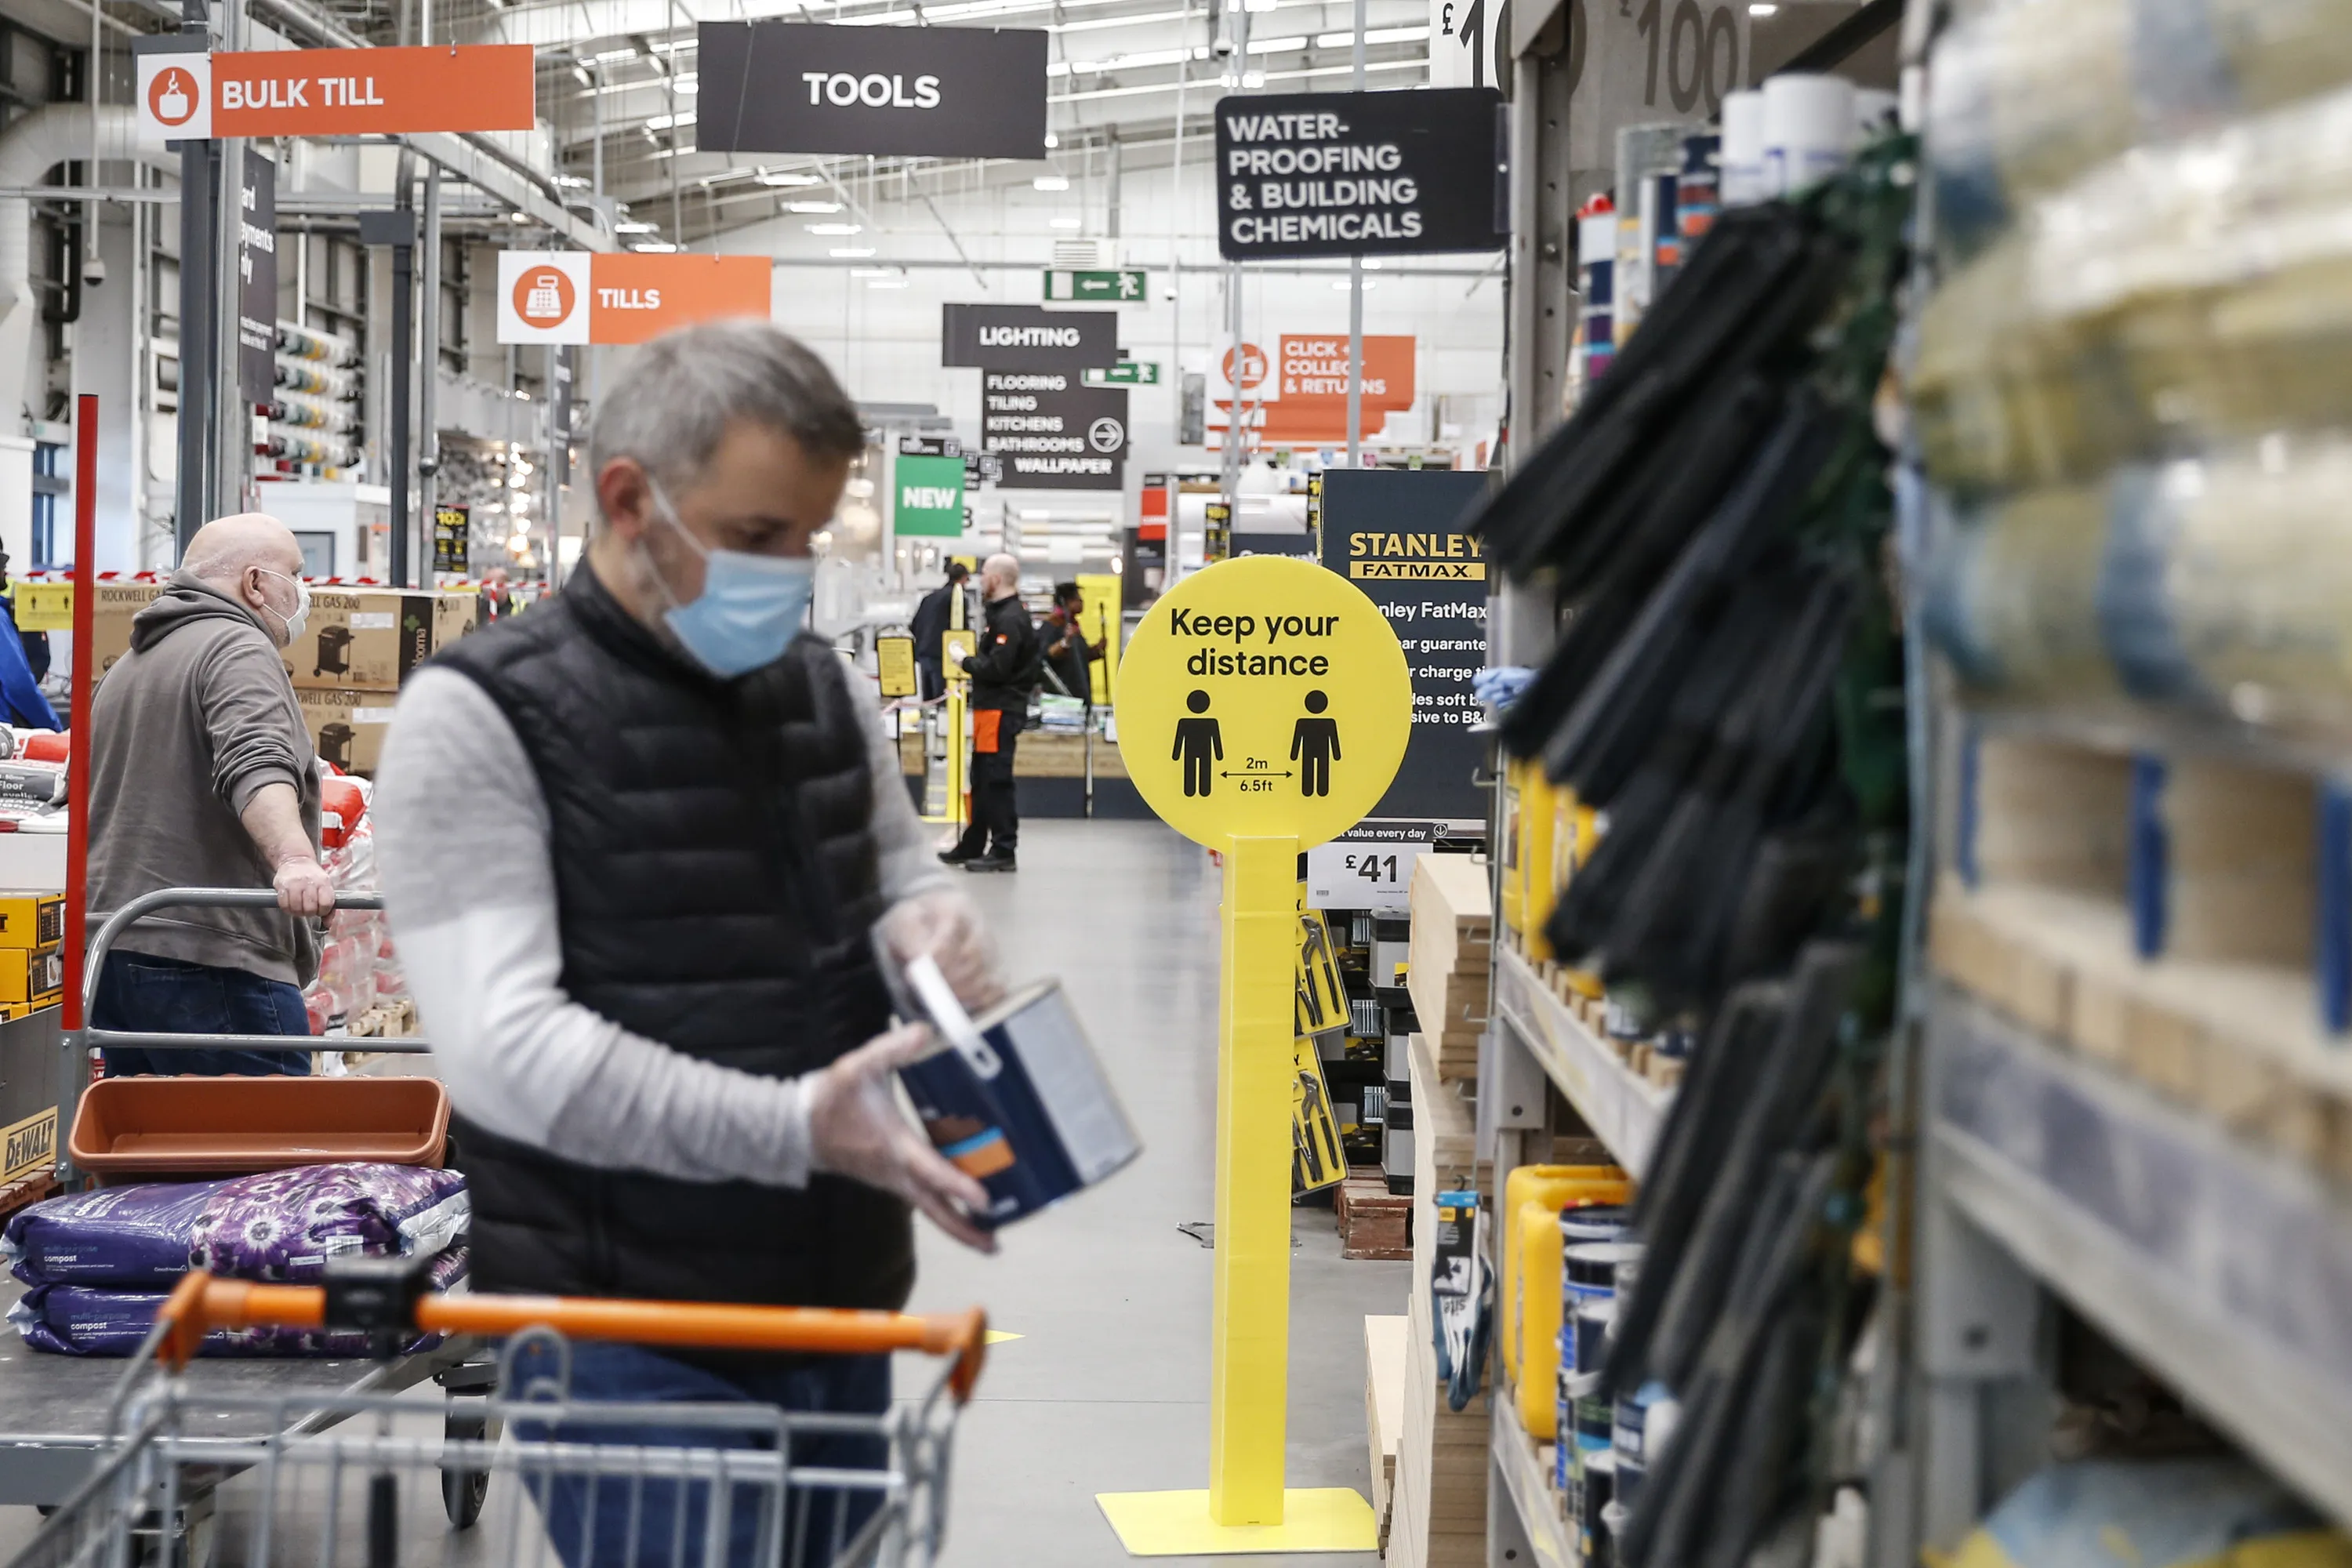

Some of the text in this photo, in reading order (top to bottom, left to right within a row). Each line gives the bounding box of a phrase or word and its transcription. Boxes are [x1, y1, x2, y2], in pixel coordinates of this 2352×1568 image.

[222, 77, 384, 109] BULK TILL
[802, 72, 942, 109] TOOLS
[1227, 114, 1350, 142] WATER-
[1229, 145, 1402, 176] PROOFING
[241, 185, 256, 212] ard
[1229, 178, 1418, 210] & BUILDING
[1231, 212, 1423, 244] CHEMICALS
[241, 220, 274, 254] ayments
[241, 250, 254, 285] nly
[597, 288, 662, 310] TILLS
[980, 326, 1081, 347] LIGHTING
[1284, 340, 1338, 357] CLICK
[1284, 359, 1366, 376] COLLEC
[987, 375, 1068, 391] FLOORING
[1284, 378, 1387, 394] & RETUNS
[987, 395, 1038, 412] TILING
[987, 416, 1064, 432] KITCHENS
[986, 436, 1086, 453] BATHROOMS
[1014, 457, 1113, 475] WALLPAPER
[902, 486, 956, 510] NEW
[1349, 532, 1486, 558] STANLEY
[1363, 564, 1469, 579] FATMAX
[101, 590, 146, 602] ROCKWELL
[323, 597, 341, 608] GAS
[343, 597, 361, 609] 200
[1378, 601, 1487, 622] nley FatMax
[1171, 608, 1340, 644] Keep your
[412, 628, 427, 670] looma
[1399, 639, 1486, 654] ar guarante
[1187, 648, 1330, 677] distance
[1419, 665, 1473, 682] charge
[325, 693, 343, 705] GAS
[1436, 693, 1466, 706] soft
[1443, 712, 1458, 724] to
[1462, 711, 1487, 724] B&
[1246, 757, 1268, 769] 2m
[1240, 780, 1273, 792] 6.5ft
[1347, 829, 1374, 838] value
[1376, 829, 1406, 840] every
[1407, 828, 1427, 840] day
[1345, 855, 1397, 883] £41
[44, 1254, 77, 1263] compost
[71, 1323, 107, 1331] compost
